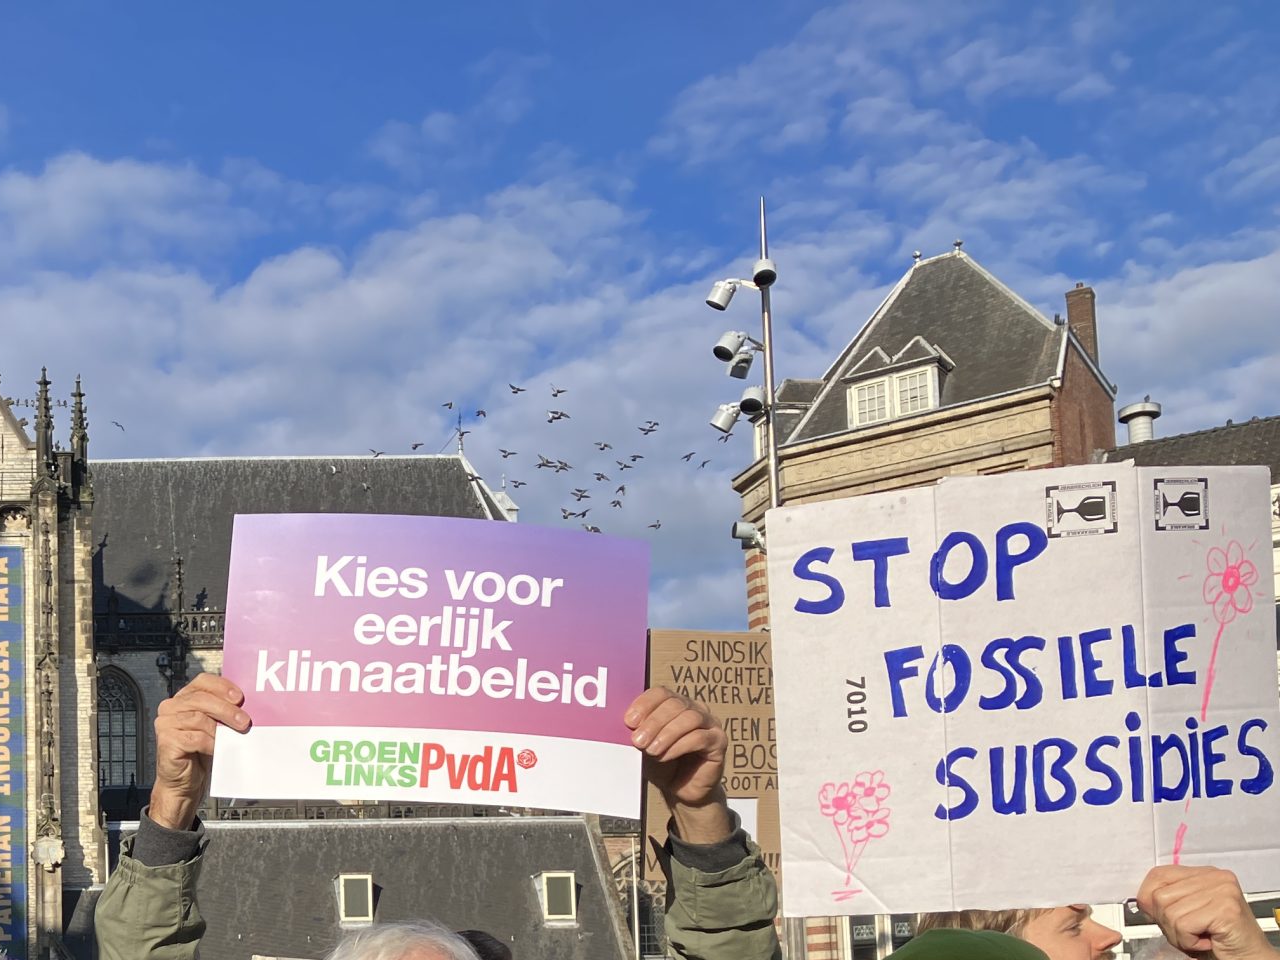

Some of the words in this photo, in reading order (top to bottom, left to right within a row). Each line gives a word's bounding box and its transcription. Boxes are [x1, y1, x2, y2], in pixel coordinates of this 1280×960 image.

[313, 555, 429, 599] Kies
[444, 568, 564, 608] voor
[793, 521, 1049, 615] STOP
[353, 605, 513, 658] eerlijk
[684, 640, 745, 664] SINDS
[749, 641, 768, 664] IK
[255, 650, 608, 708] klimaatbeleid
[884, 624, 1197, 718] FOSSIELE
[845, 676, 868, 733] 7010
[309, 740, 420, 764] GROEN
[325, 763, 418, 788] LINKS
[419, 742, 518, 793] PvdA
[721, 775, 761, 792] ROOT
